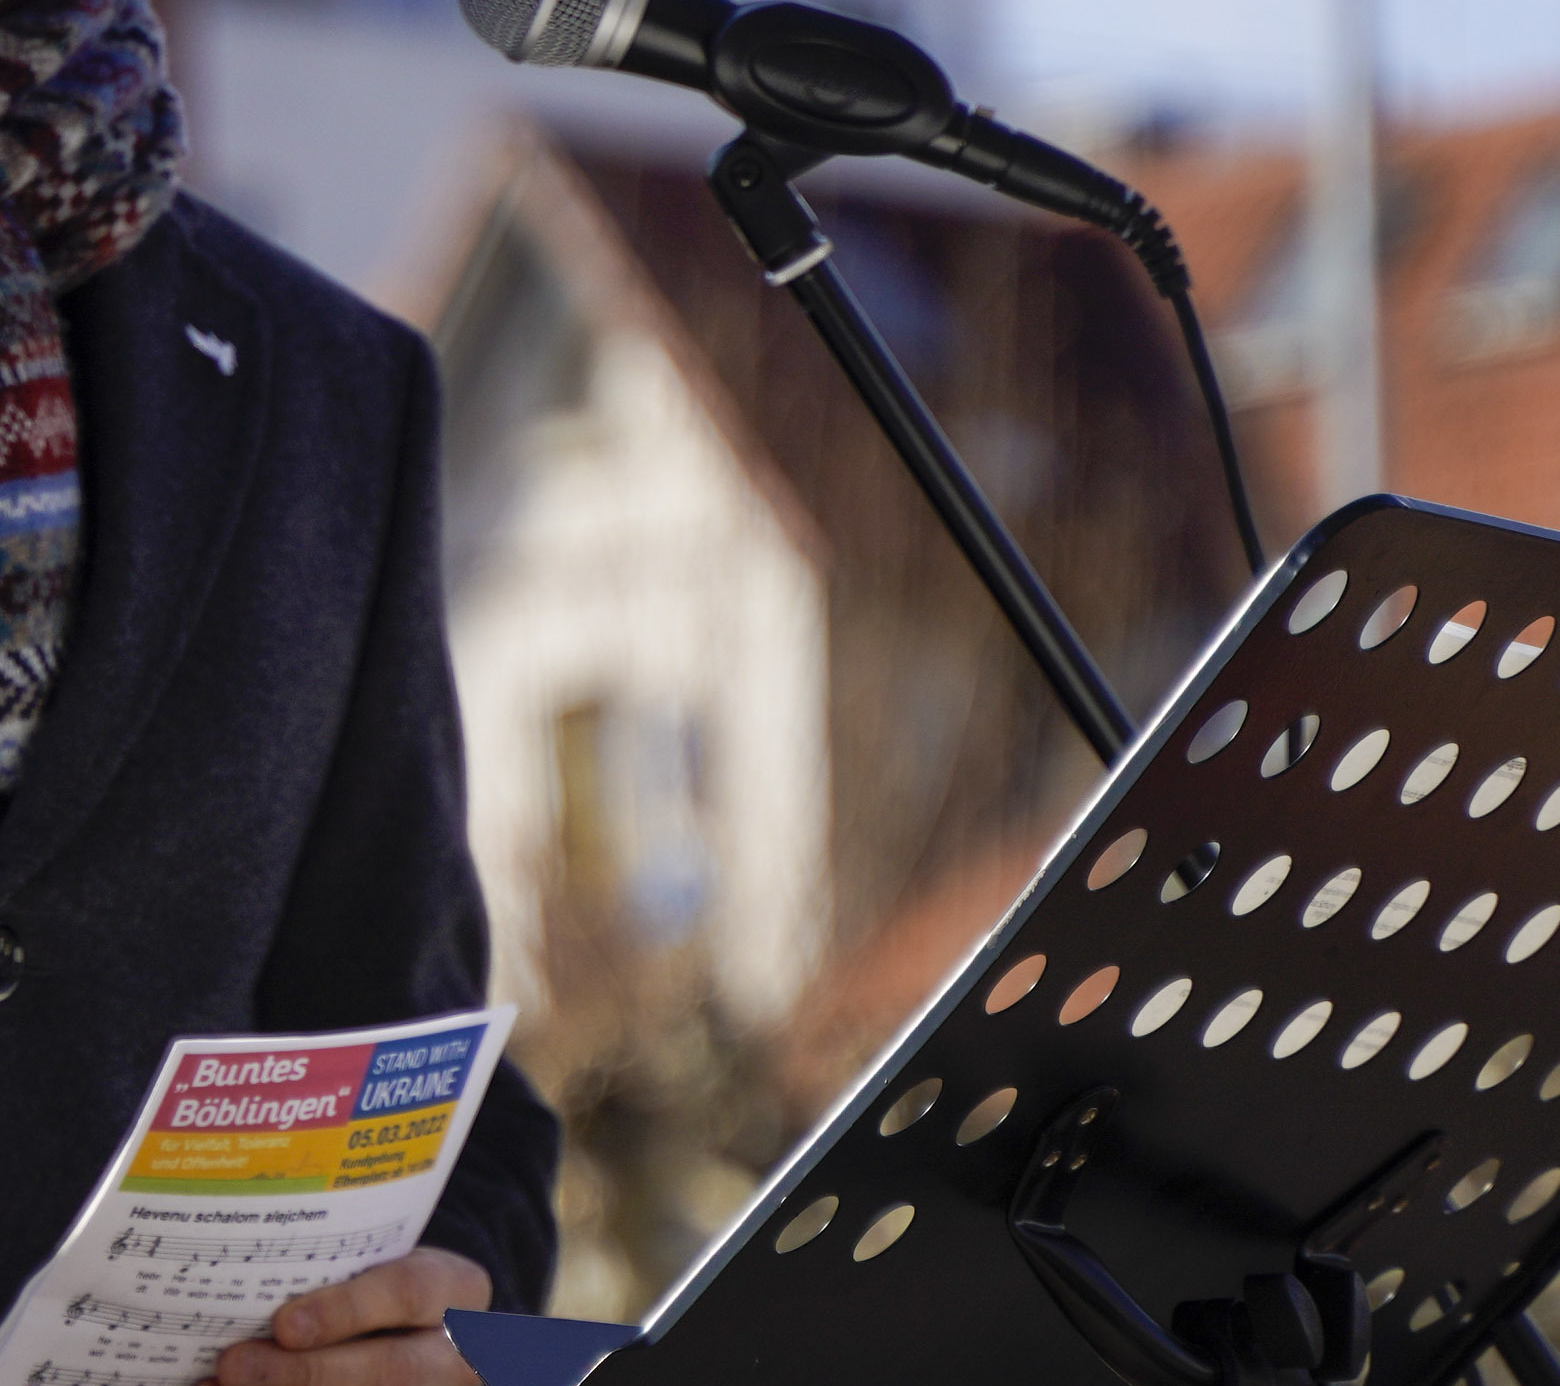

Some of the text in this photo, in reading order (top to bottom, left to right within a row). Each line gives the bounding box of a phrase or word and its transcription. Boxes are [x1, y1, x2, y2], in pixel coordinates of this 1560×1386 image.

[174, 1055, 310, 1093] „Buntes
[372, 1038, 472, 1075] STAND WITH
[360, 1066, 462, 1112] UKRAINE
[170, 1086, 352, 1130] Böblingen“
[347, 1113, 448, 1150] 05.03.2022
[129, 1205, 328, 1226] Hevenu schalom alejchem
